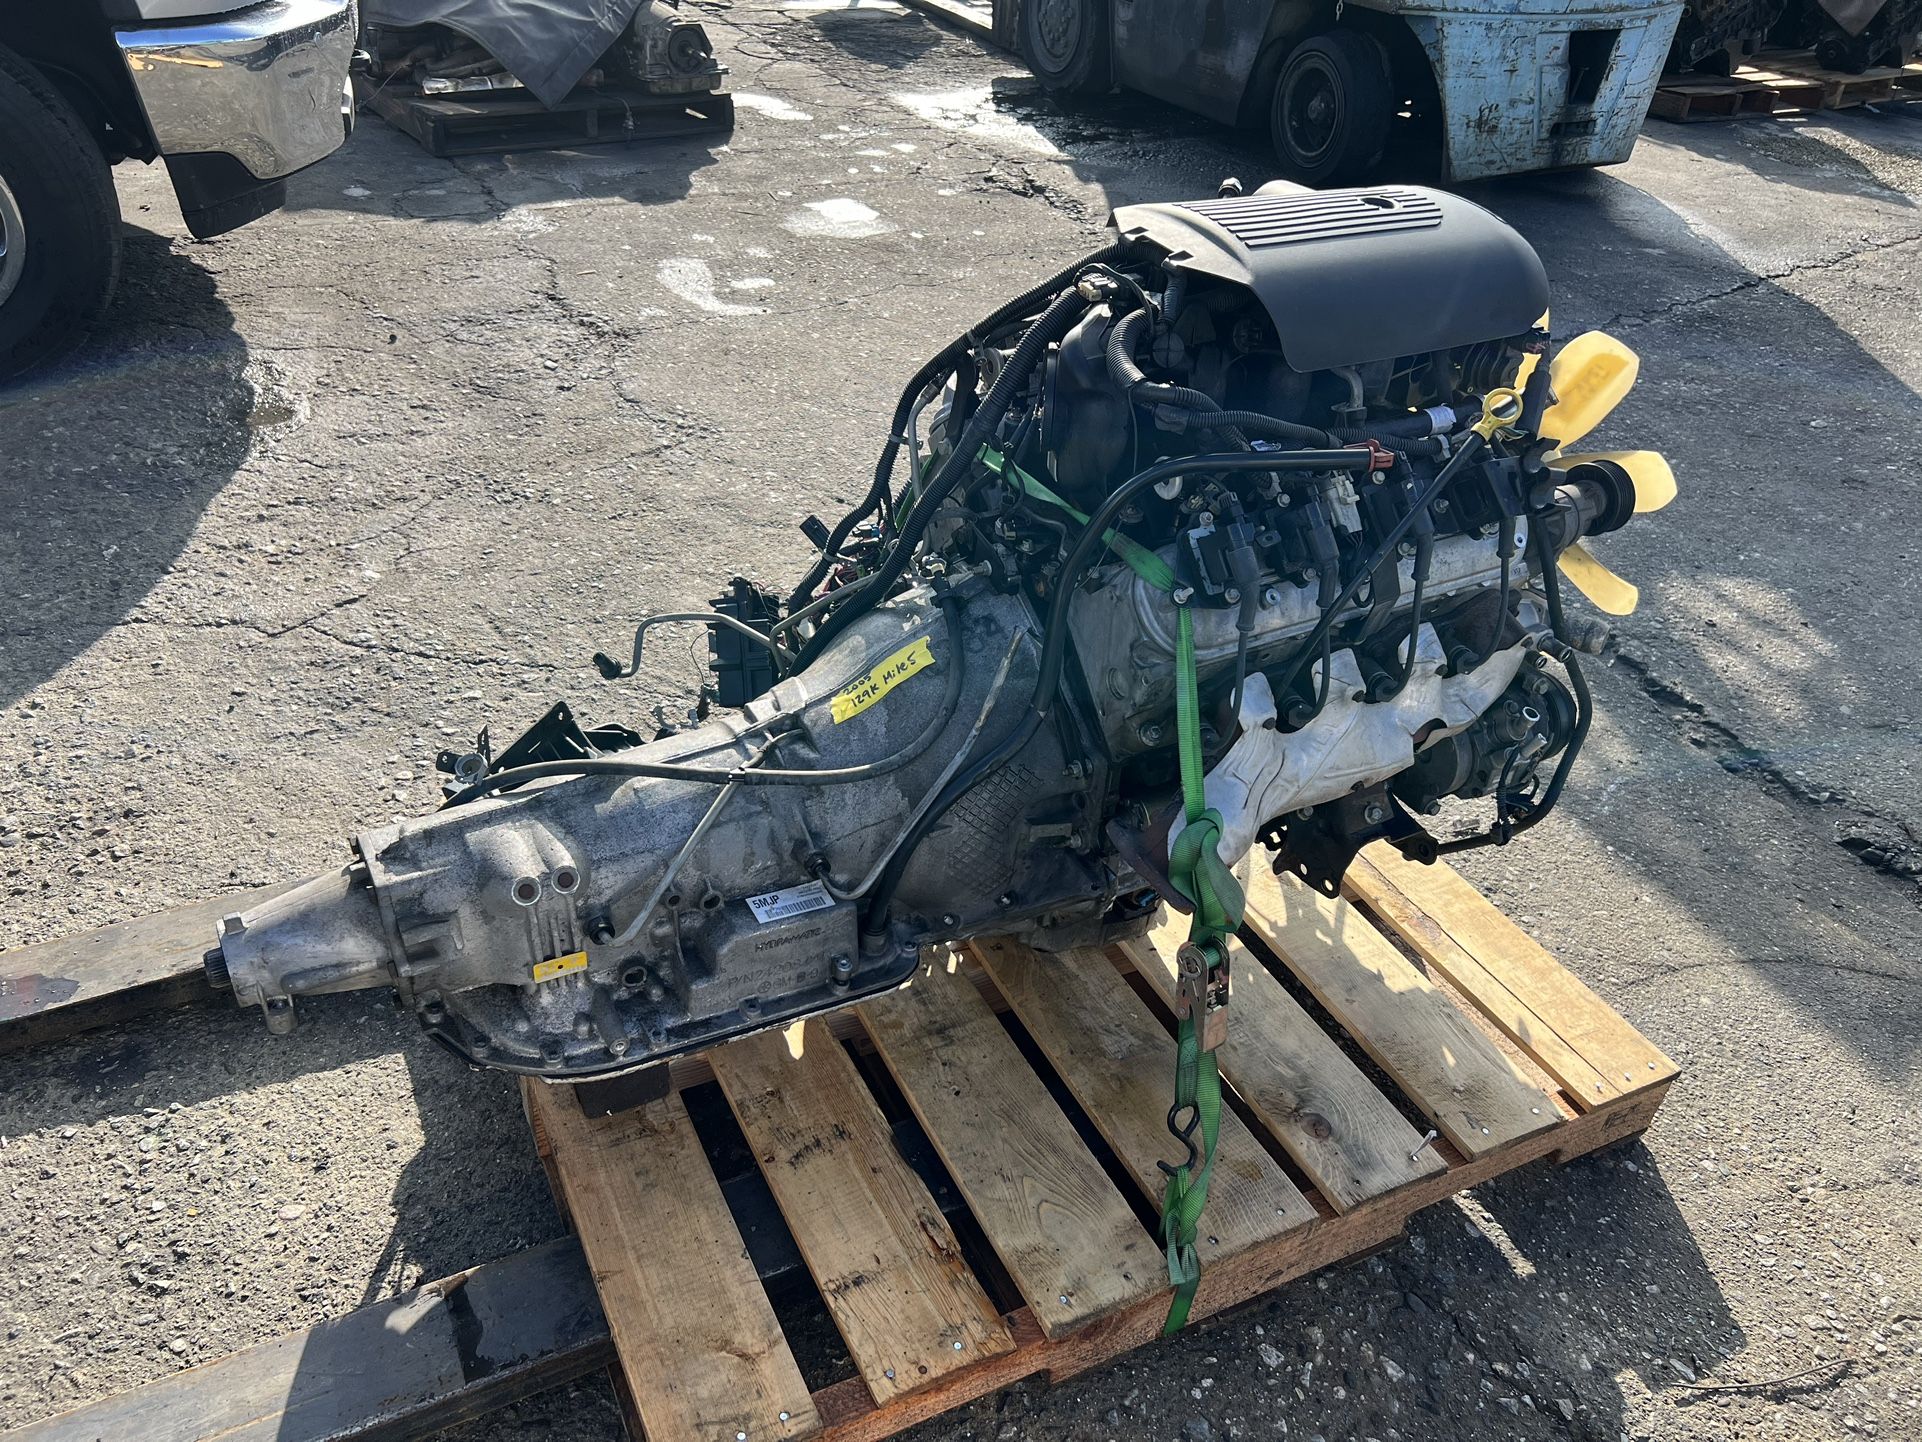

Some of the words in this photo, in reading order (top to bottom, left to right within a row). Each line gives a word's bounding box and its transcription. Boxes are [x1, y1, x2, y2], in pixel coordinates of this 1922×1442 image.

[843, 674, 872, 695] 2005
[851, 683, 880, 708] 129K
[752, 894, 780, 909] 5MJP
